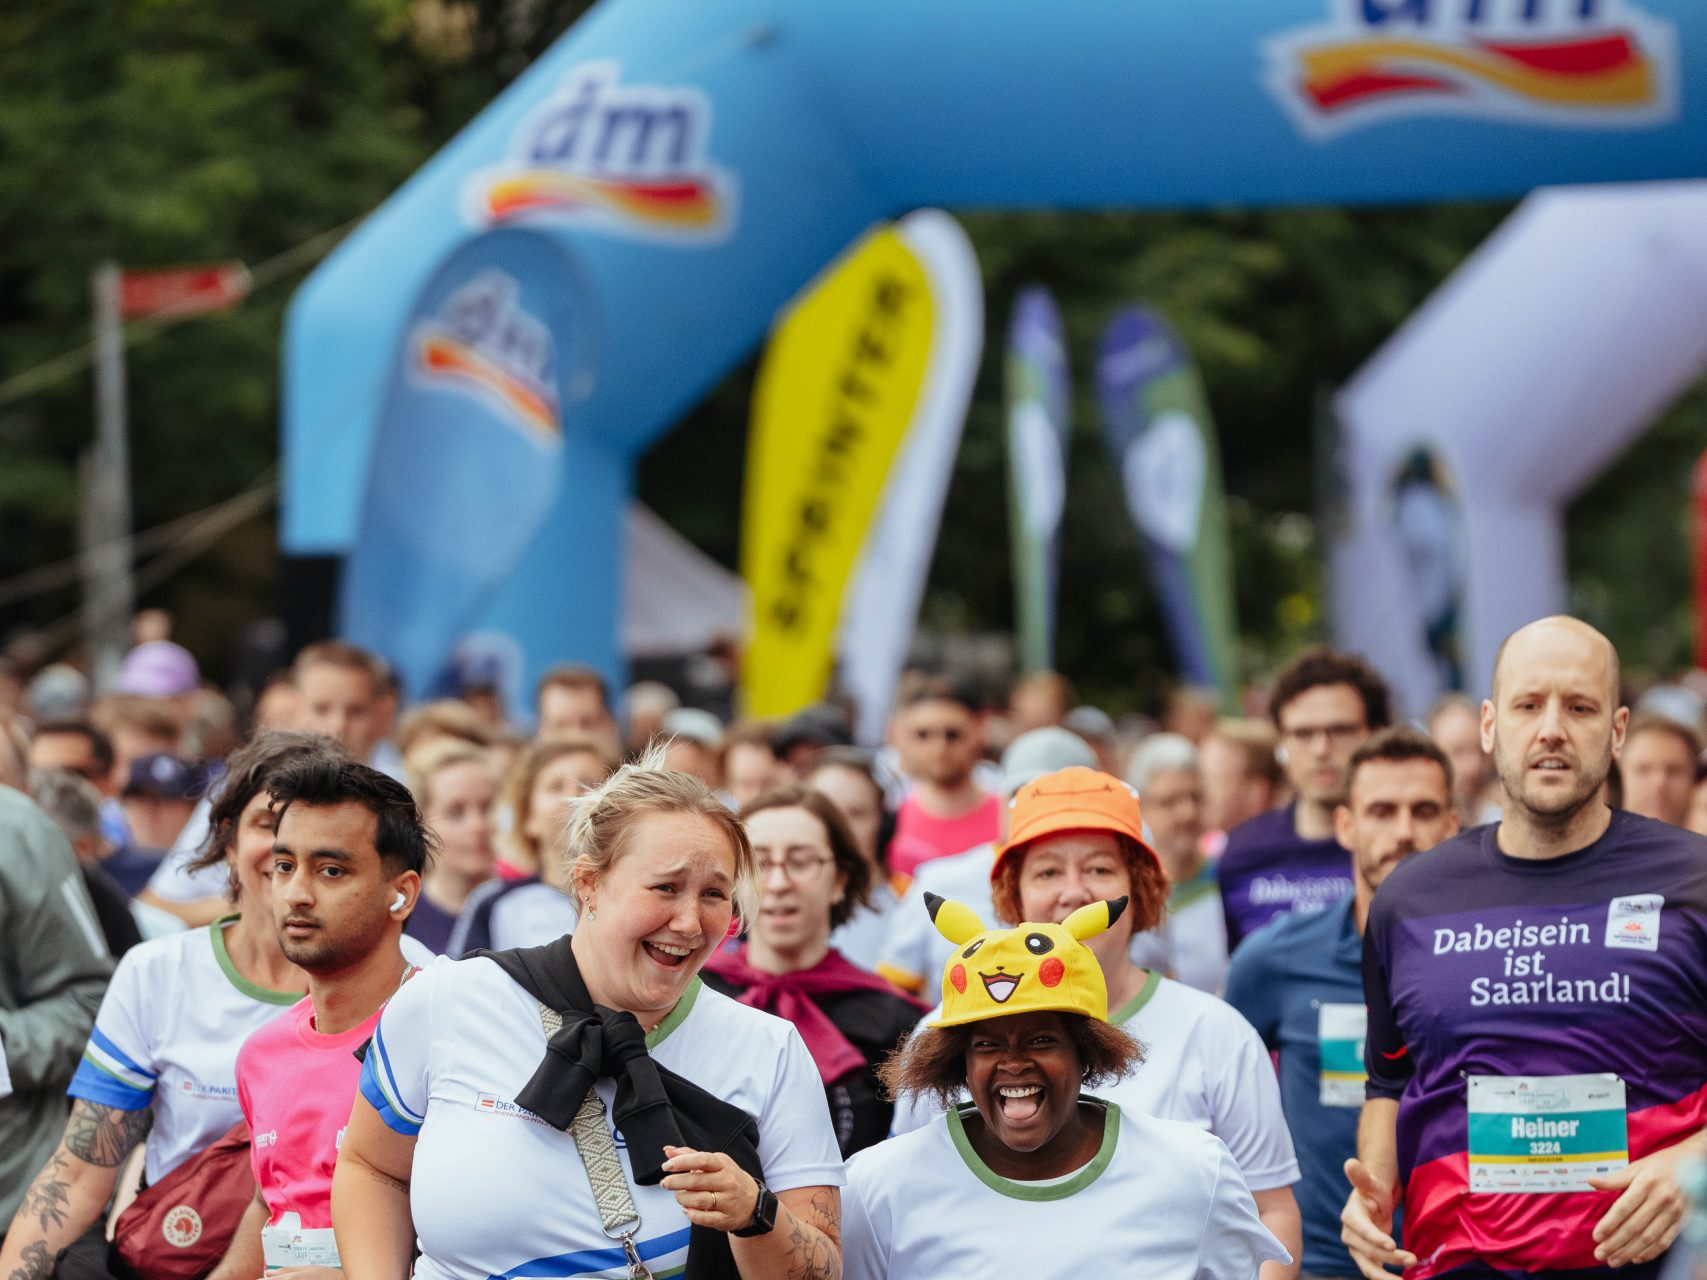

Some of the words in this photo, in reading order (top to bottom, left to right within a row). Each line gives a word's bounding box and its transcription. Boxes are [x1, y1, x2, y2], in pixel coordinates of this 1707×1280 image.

[526, 78, 692, 166] dm
[1433, 917, 1590, 955] Dabeisein
[1504, 949, 1545, 976] ist
[1470, 972, 1629, 1006] Saarland!
[495, 1101, 515, 1112] DER
[1511, 1117, 1579, 1138] Heiner
[1530, 1141, 1562, 1155] 3224
